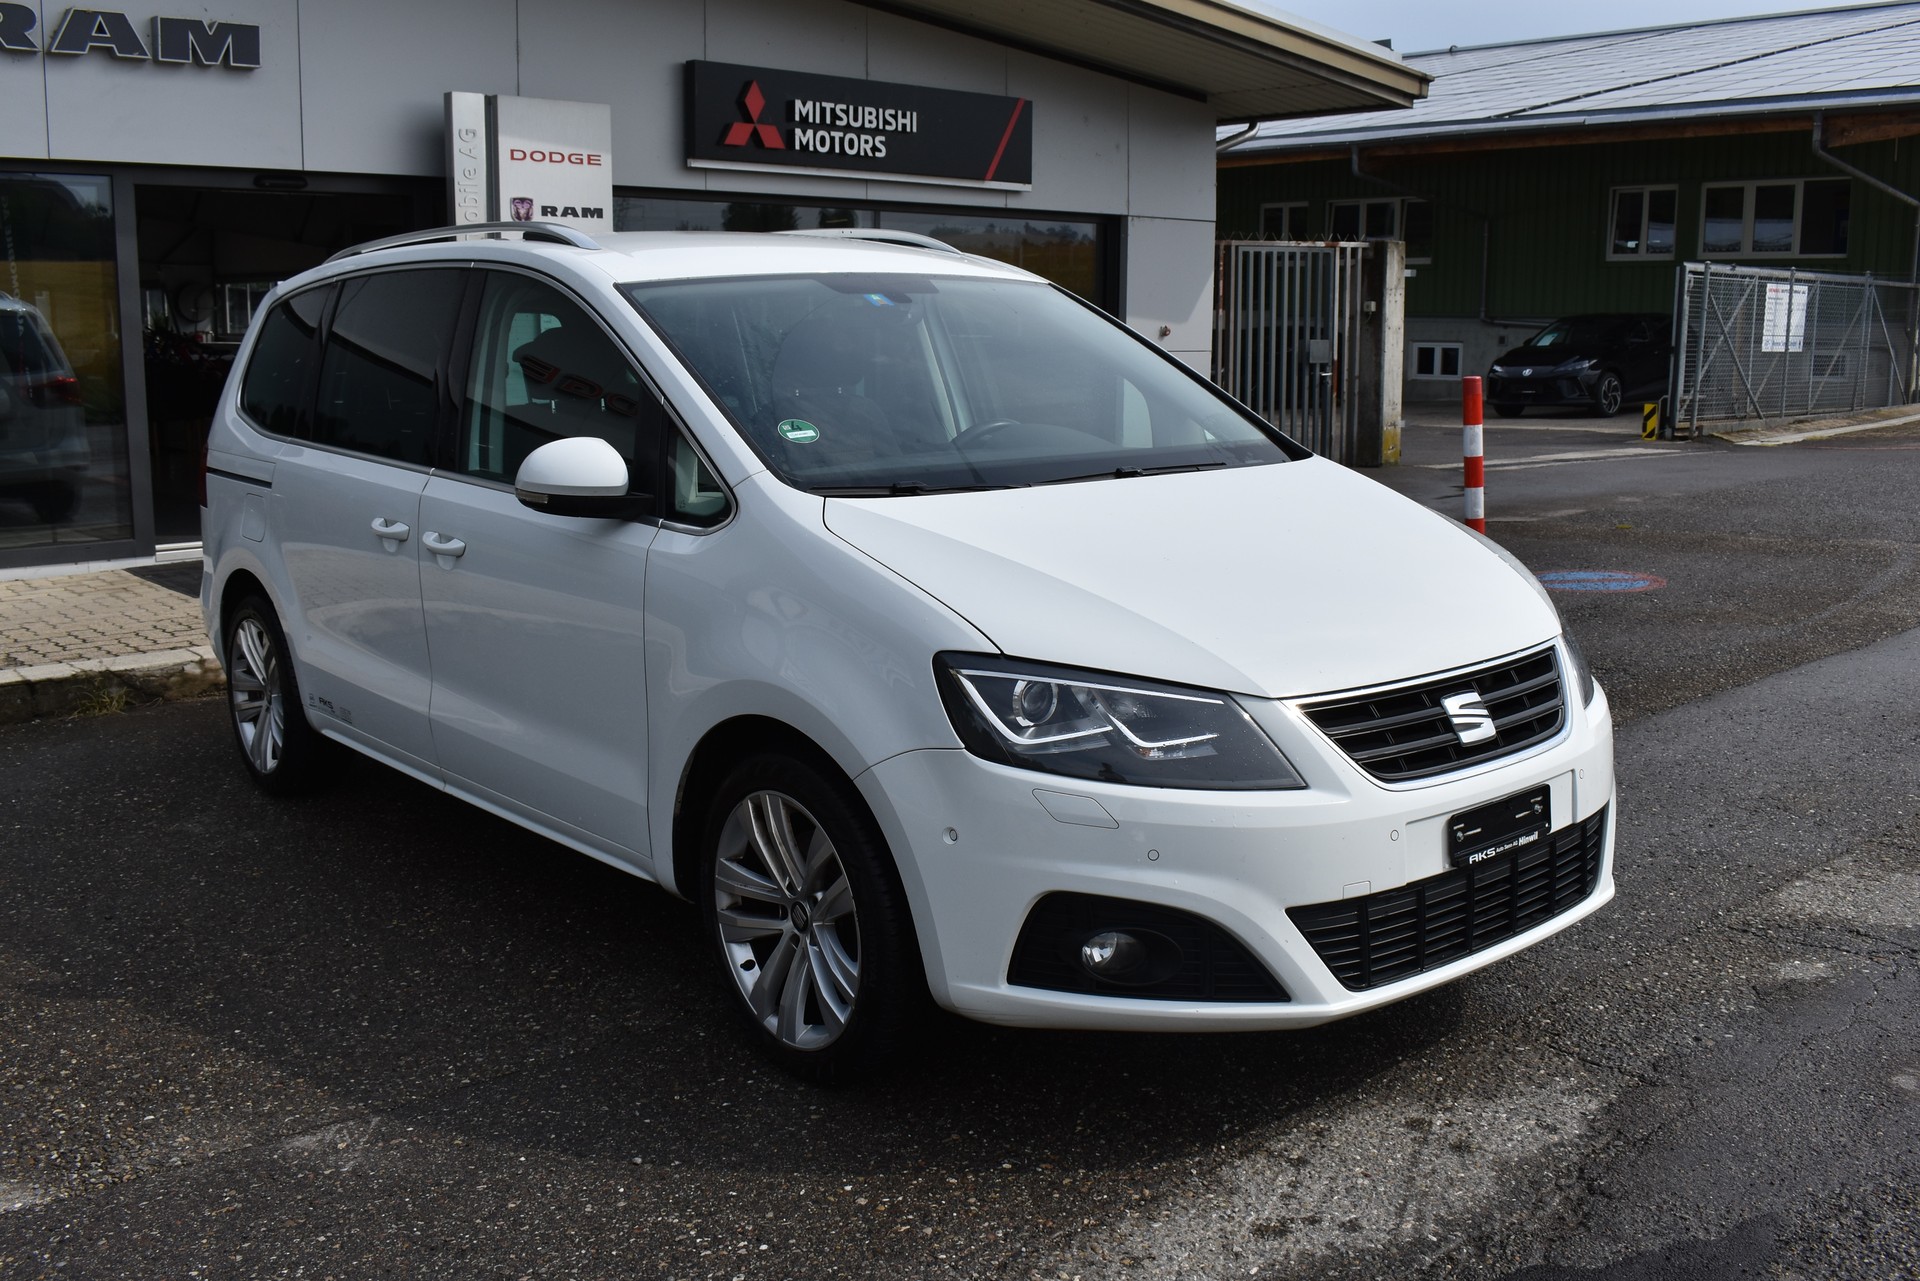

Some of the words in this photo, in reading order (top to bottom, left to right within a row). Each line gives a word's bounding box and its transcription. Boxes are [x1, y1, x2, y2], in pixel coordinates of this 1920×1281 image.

[795, 99, 917, 133] MITSUBISHI
[458, 128, 477, 160] AG
[510, 148, 601, 166] DODGE
[795, 128, 887, 158] MOTORS
[541, 205, 604, 219] RAM
[791, 421, 802, 431] 4
[1469, 847, 1496, 865] AKS
[1518, 831, 1539, 847] Hinwil
